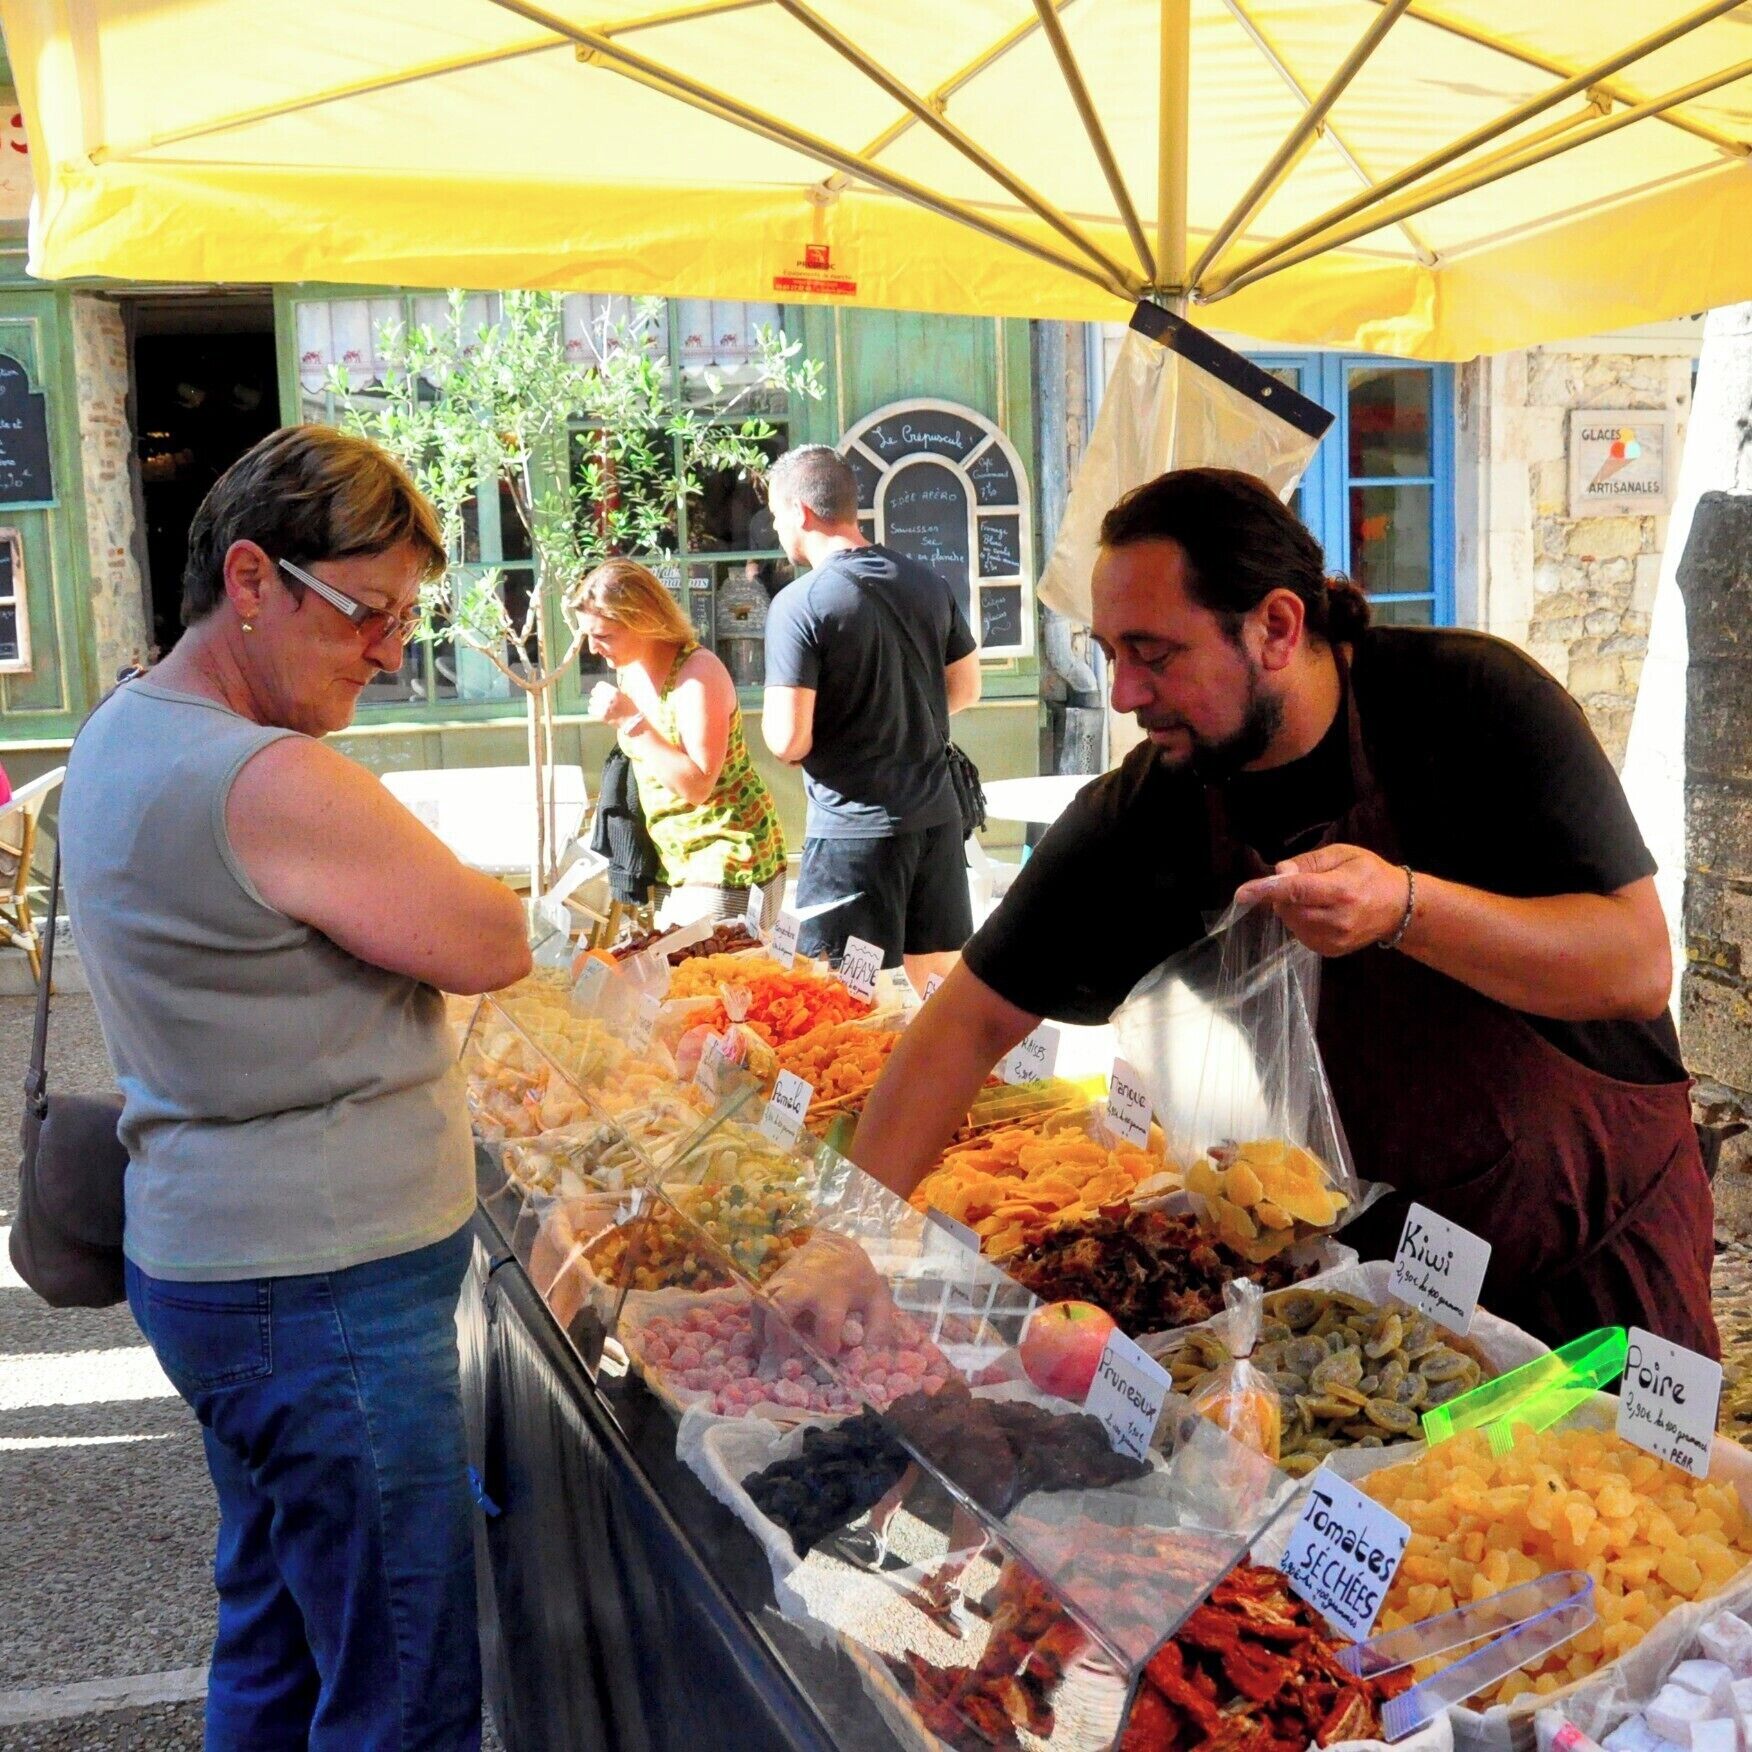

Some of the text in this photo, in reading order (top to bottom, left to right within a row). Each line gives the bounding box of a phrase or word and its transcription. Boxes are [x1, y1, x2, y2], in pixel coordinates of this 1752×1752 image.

[872, 425, 898, 449] Le
[1581, 428, 1622, 441] GLACES
[1588, 480, 1660, 494] ARTISANALES
[840, 953, 880, 987] PAPAYE
[1399, 1221, 1454, 1277] Kiwi
[1623, 1345, 1686, 1405] Poire
[1669, 1448, 1695, 1471] PEAR
[1304, 1490, 1396, 1583] Tomates
[1300, 1542, 1379, 1620] SÉCHÉES
